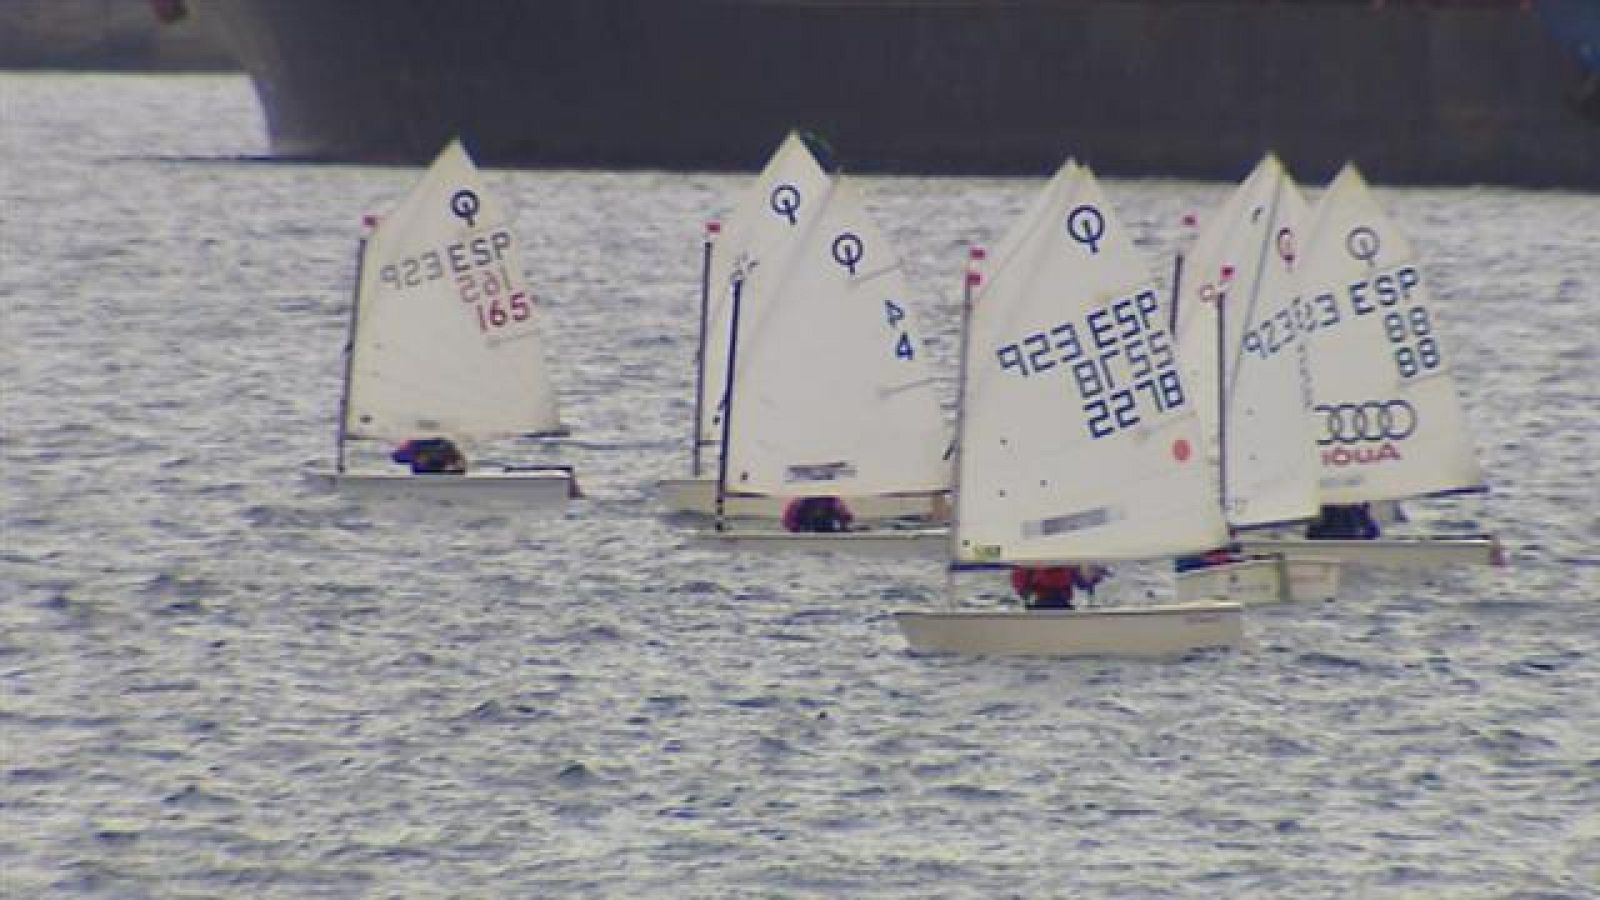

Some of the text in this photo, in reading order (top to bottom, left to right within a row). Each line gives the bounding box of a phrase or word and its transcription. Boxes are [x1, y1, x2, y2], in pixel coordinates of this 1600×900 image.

[448, 232, 510, 273] ESP
[477, 292, 530, 331] 165
[1349, 268, 1418, 314] ESP
[1087, 290, 1158, 348] ESP
[895, 332, 914, 360] 4
[1397, 338, 1439, 378] 88
[1083, 370, 1185, 438] 2278
